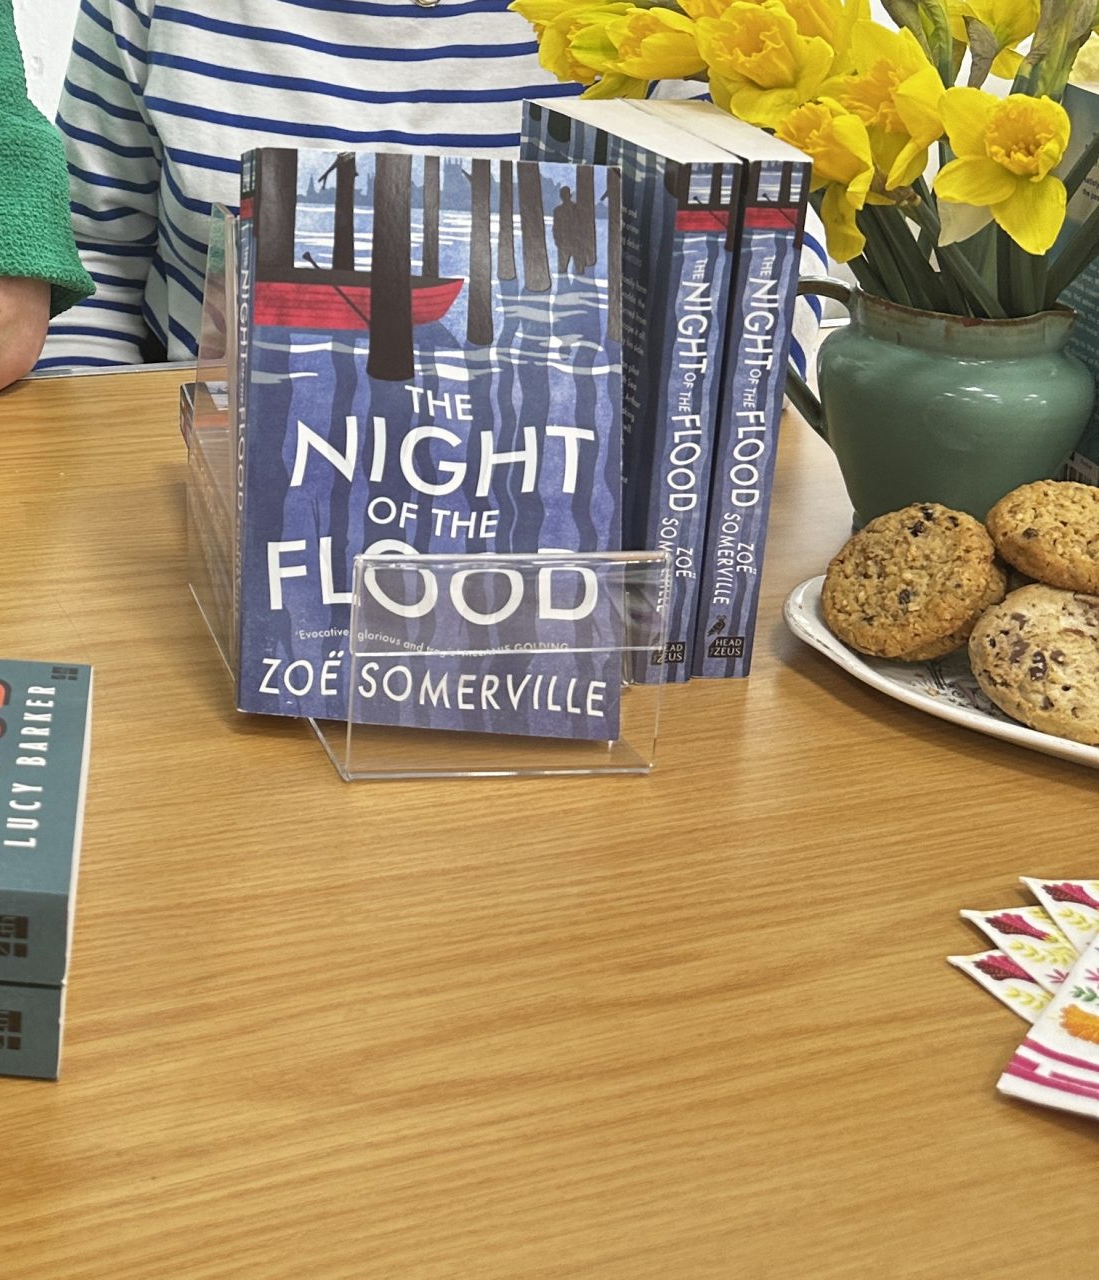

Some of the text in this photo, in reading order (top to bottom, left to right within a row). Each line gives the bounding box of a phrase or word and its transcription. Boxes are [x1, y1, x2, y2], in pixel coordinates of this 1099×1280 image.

[667, 257, 712, 511] THE NIGHT OF THE FLOOD
[730, 255, 779, 507] THE NIGHT OF THE FLOOD
[404, 385, 473, 421] THE
[289, 416, 595, 497] NIGHT
[367, 496, 499, 538] OF THE
[676, 547, 696, 579] ZOË
[712, 512, 741, 605] SOMERVILLE
[736, 543, 758, 574] ZOË
[267, 537, 598, 625] FLOOD
[357, 629, 400, 646] glorious
[403, 640, 424, 654] and
[661, 643, 683, 653] EAD
[714, 647, 741, 657] ZEUS
[716, 638, 742, 647] HEAD
[259, 649, 607, 717] ZOË SOMERVILLE
[4, 685, 56, 848] LUCY BARKER
